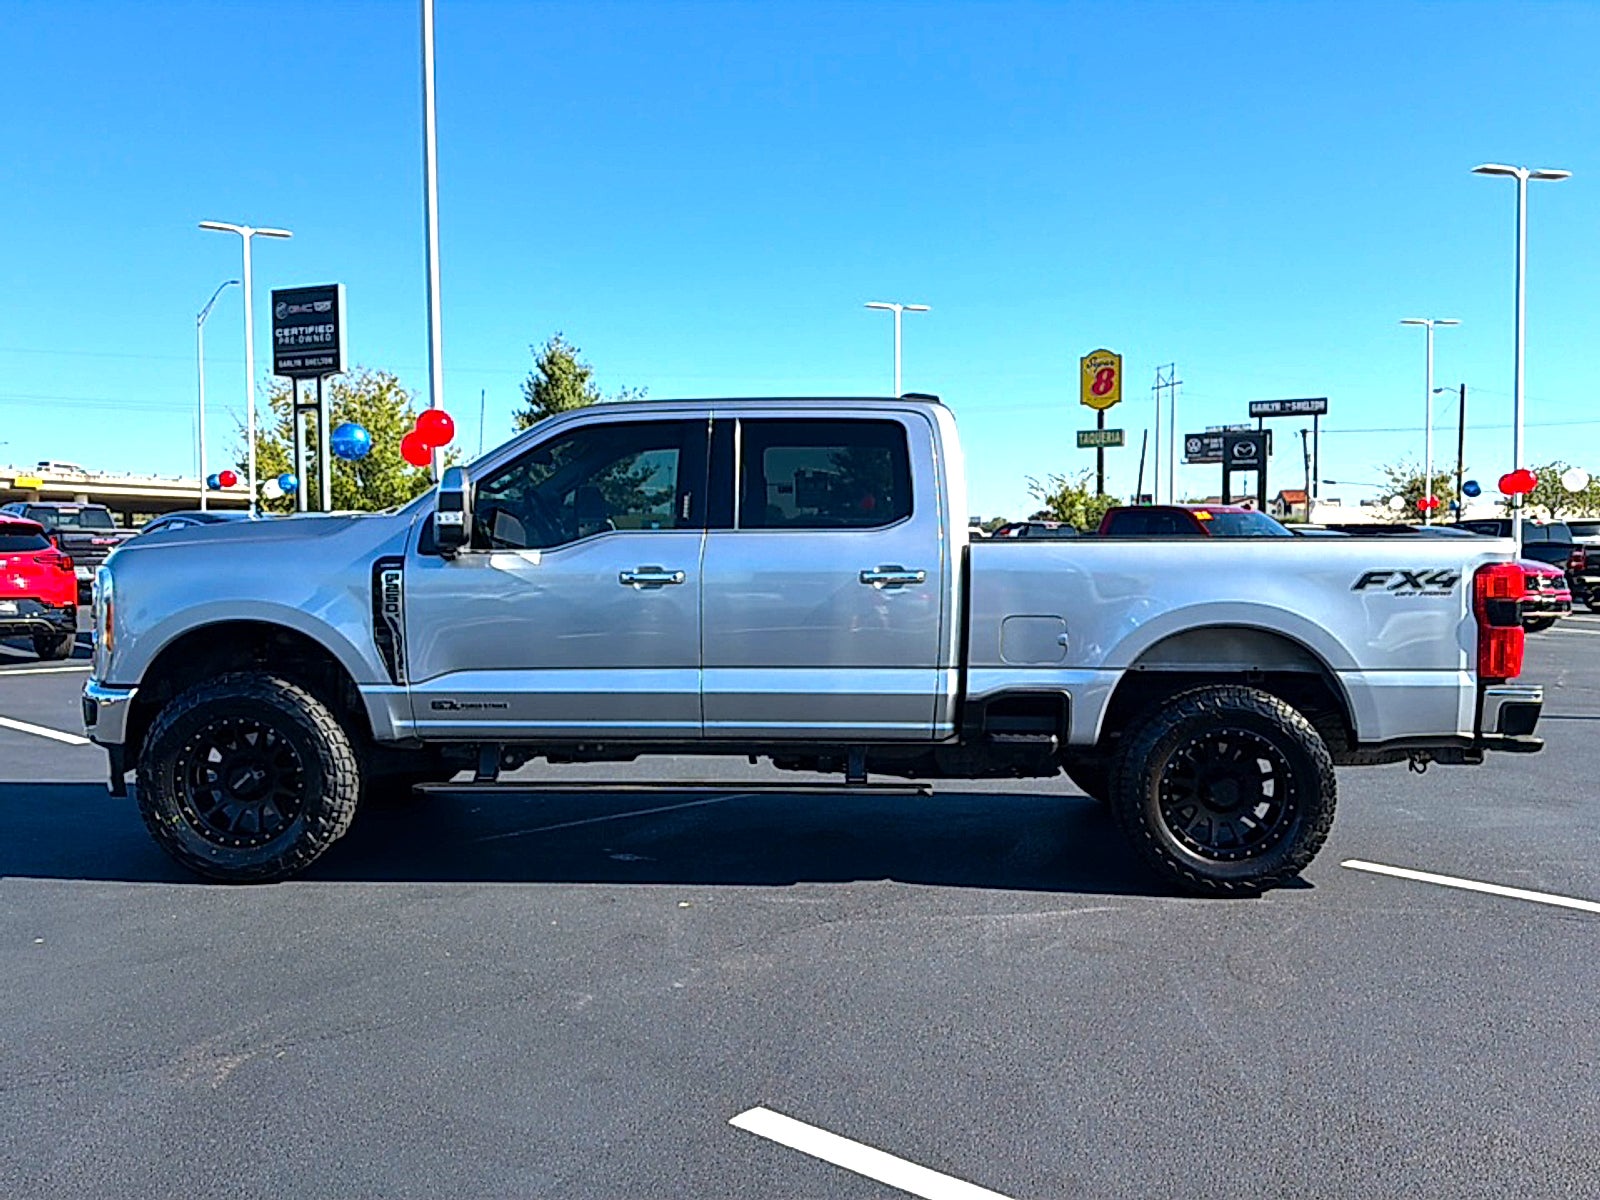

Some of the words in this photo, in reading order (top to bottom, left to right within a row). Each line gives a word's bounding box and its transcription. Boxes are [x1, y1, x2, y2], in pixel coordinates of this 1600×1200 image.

[288, 304, 313, 314] GMC
[275, 324, 334, 337] CERTIFIED
[278, 333, 331, 344] PRE-OWNED
[1091, 367, 1115, 396] 8
[1291, 400, 1325, 411] SHELTON
[1079, 431, 1121, 445] TAQUERIA
[1350, 568, 1462, 591] FX4
